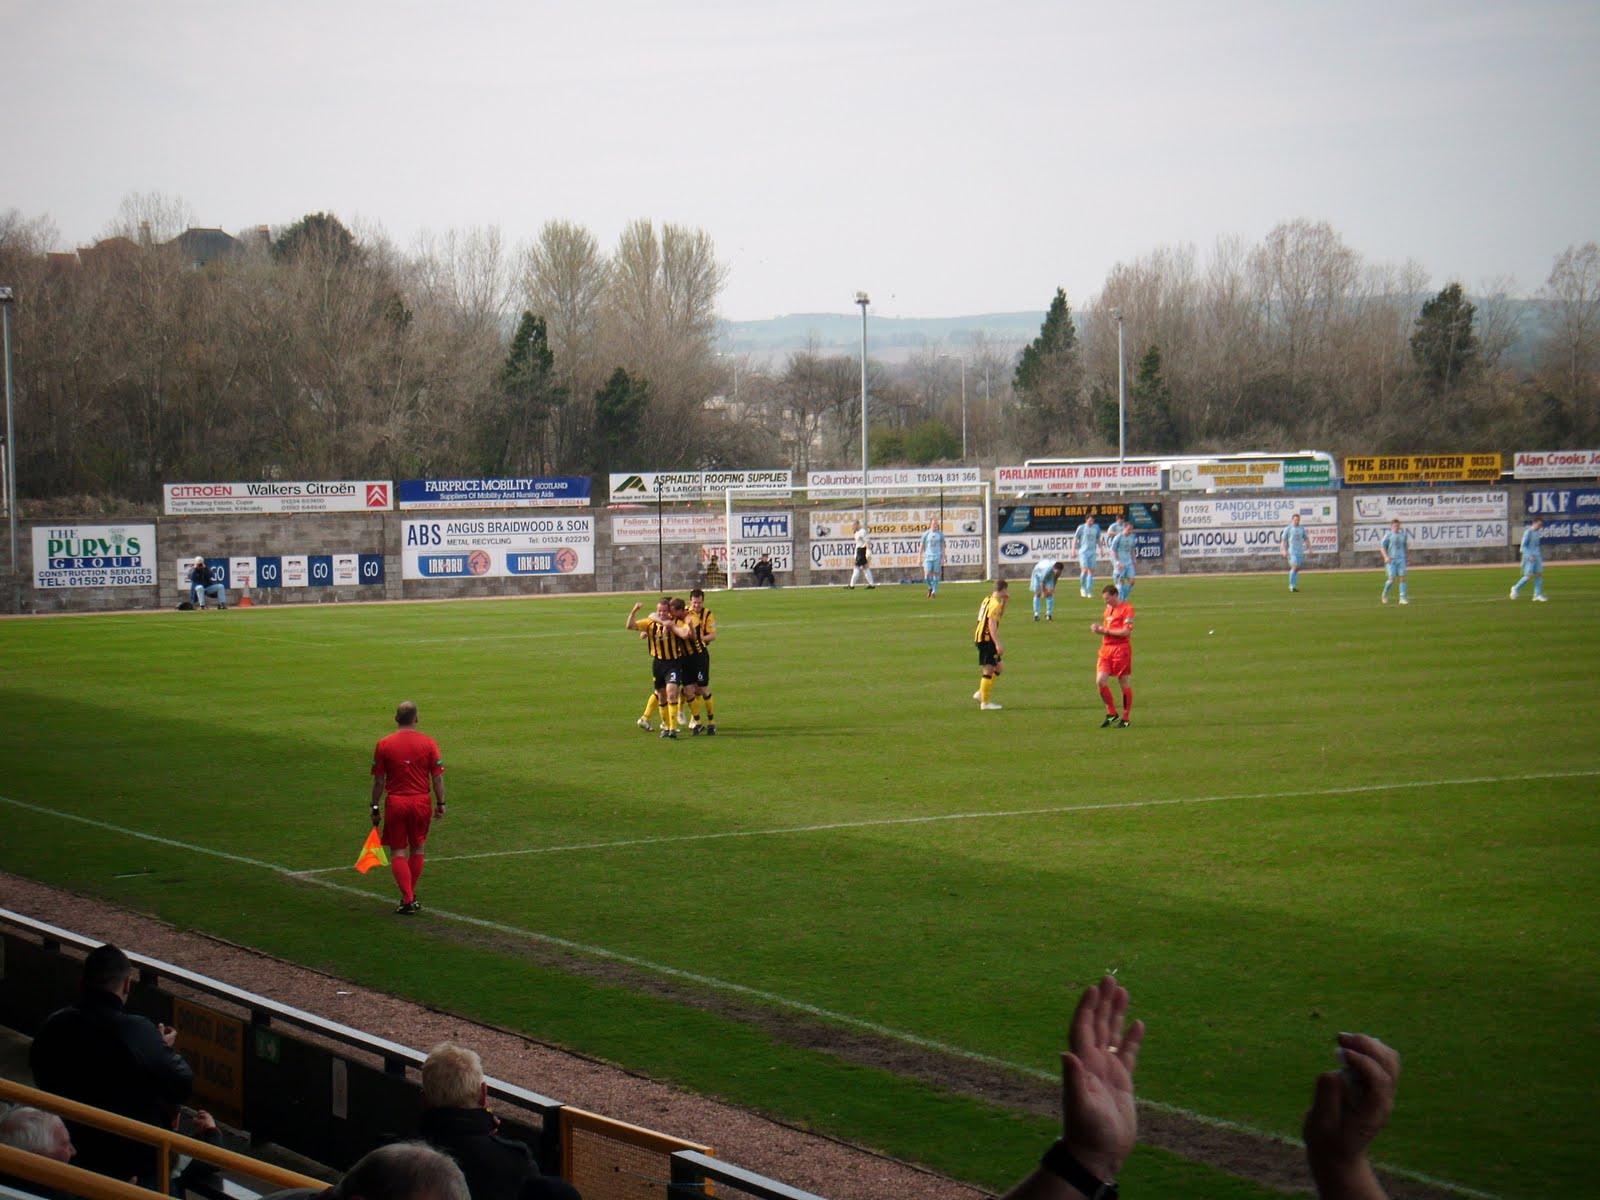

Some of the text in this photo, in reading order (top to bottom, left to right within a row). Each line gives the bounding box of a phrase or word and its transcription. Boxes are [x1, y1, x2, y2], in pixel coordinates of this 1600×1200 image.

[1348, 457, 1465, 472] THE BRIG TAVERN
[1517, 455, 1543, 466] Alan
[1547, 453, 1585, 464] Crooks
[653, 472, 788, 485] ASPHALTIC ROOFING SUPPLIES
[946, 473, 959, 482] 831
[962, 472, 976, 481] 366
[1000, 465, 1157, 480] PARLIAMENTARY ADVICE CENTRE
[1368, 473, 1395, 481] YARDS
[1397, 472, 1420, 480] FROM
[1424, 470, 1463, 480] BAYVIEW
[425, 480, 479, 492] FAIRPRICE
[481, 479, 533, 491] MOBILITY
[811, 473, 908, 487] Collumbine Limos Ltd
[171, 485, 232, 498] CITROËN
[247, 483, 356, 496] Walkers Citroën
[672, 484, 709, 494] LARGEST
[1047, 482, 1074, 491] LINDSAY
[439, 492, 468, 501] Suppliers
[478, 491, 502, 500] Mobility
[503, 490, 516, 498] And
[517, 490, 541, 499] Nursing
[542, 489, 555, 497] Aids
[1387, 497, 1434, 507] Motoring
[1437, 495, 1484, 504] Services
[1487, 494, 1504, 503] Ltd
[1215, 501, 1271, 511] RANDOLPH
[1274, 500, 1295, 510] GAS
[1528, 492, 1571, 513] JKF
[1033, 506, 1061, 517] HENRY
[1064, 505, 1087, 516] GRAY
[1090, 505, 1097, 515] &
[1101, 504, 1124, 515] SONS
[1184, 506, 1209, 514] 01592
[1231, 510, 1280, 521] SUPPLIES
[623, 518, 649, 526] Follow
[667, 516, 689, 525] Fifers
[743, 515, 787, 524] EAST FIFE
[446, 520, 589, 534] ANGUS BRAIDWOOD & SON
[663, 527, 677, 535] the
[678, 526, 706, 534] season
[708, 525, 716, 533] in
[743, 525, 787, 538] MAIL
[1421, 526, 1473, 540] BUFFET
[1476, 525, 1505, 538] BAR
[48, 529, 79, 539] THE
[407, 524, 442, 546] ABS
[565, 535, 590, 543] 622210
[48, 538, 141, 558] PURVIS
[949, 539, 980, 549] 70-70-70
[1005, 542, 1025, 556] Ford
[53, 558, 141, 569] GROUP
[896, 556, 922, 565] DRIV
[950, 555, 980, 565] 42-11-11
[39, 570, 107, 578] CONSTRUCTION
[262, 565, 277, 580] GO
[313, 563, 328, 578] GO
[363, 561, 379, 576] GO
[39, 575, 153, 587] TEL: 01592 780492
[670, 672, 677, 682] 3
[698, 671, 704, 680] 6
